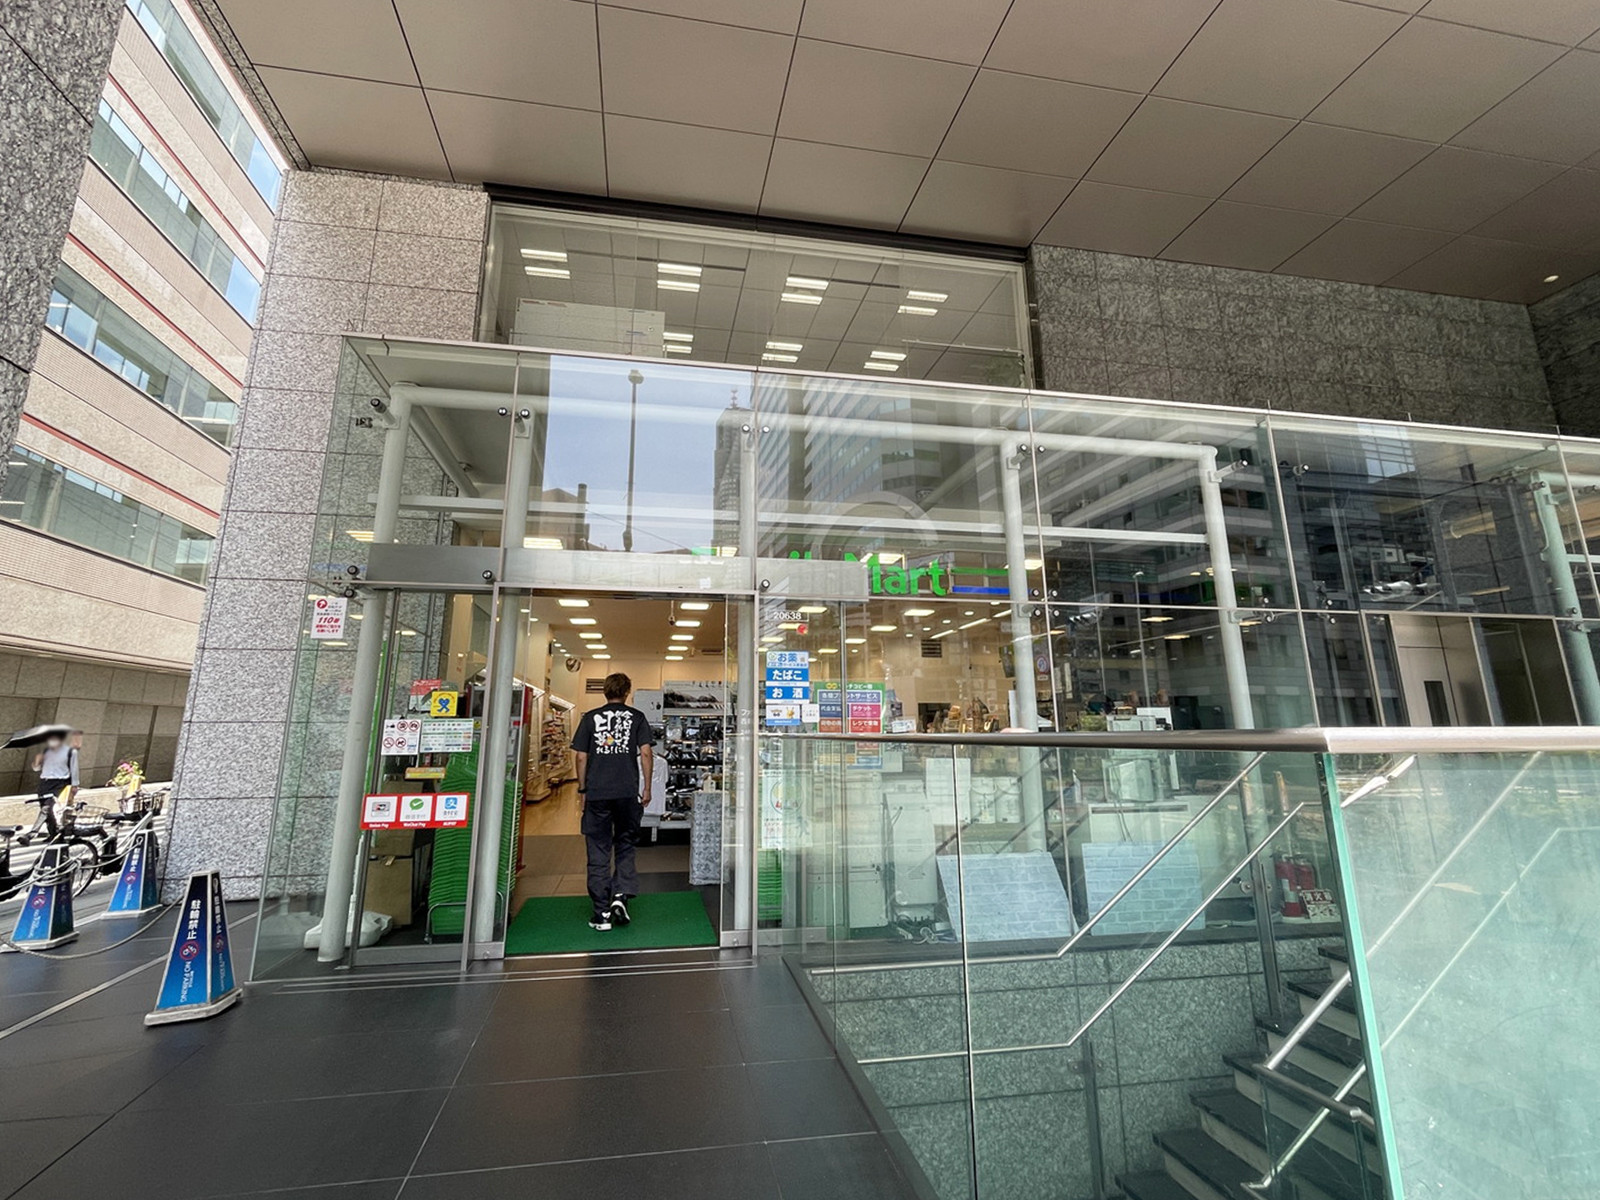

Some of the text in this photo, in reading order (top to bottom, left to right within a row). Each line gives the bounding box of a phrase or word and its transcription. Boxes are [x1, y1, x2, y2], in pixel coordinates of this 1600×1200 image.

[773, 611, 802, 620] 20638
[772, 669, 803, 680] たばこ
[187, 899, 202, 940] 駐輪禁止
[180, 961, 192, 1003] NO PARKING
